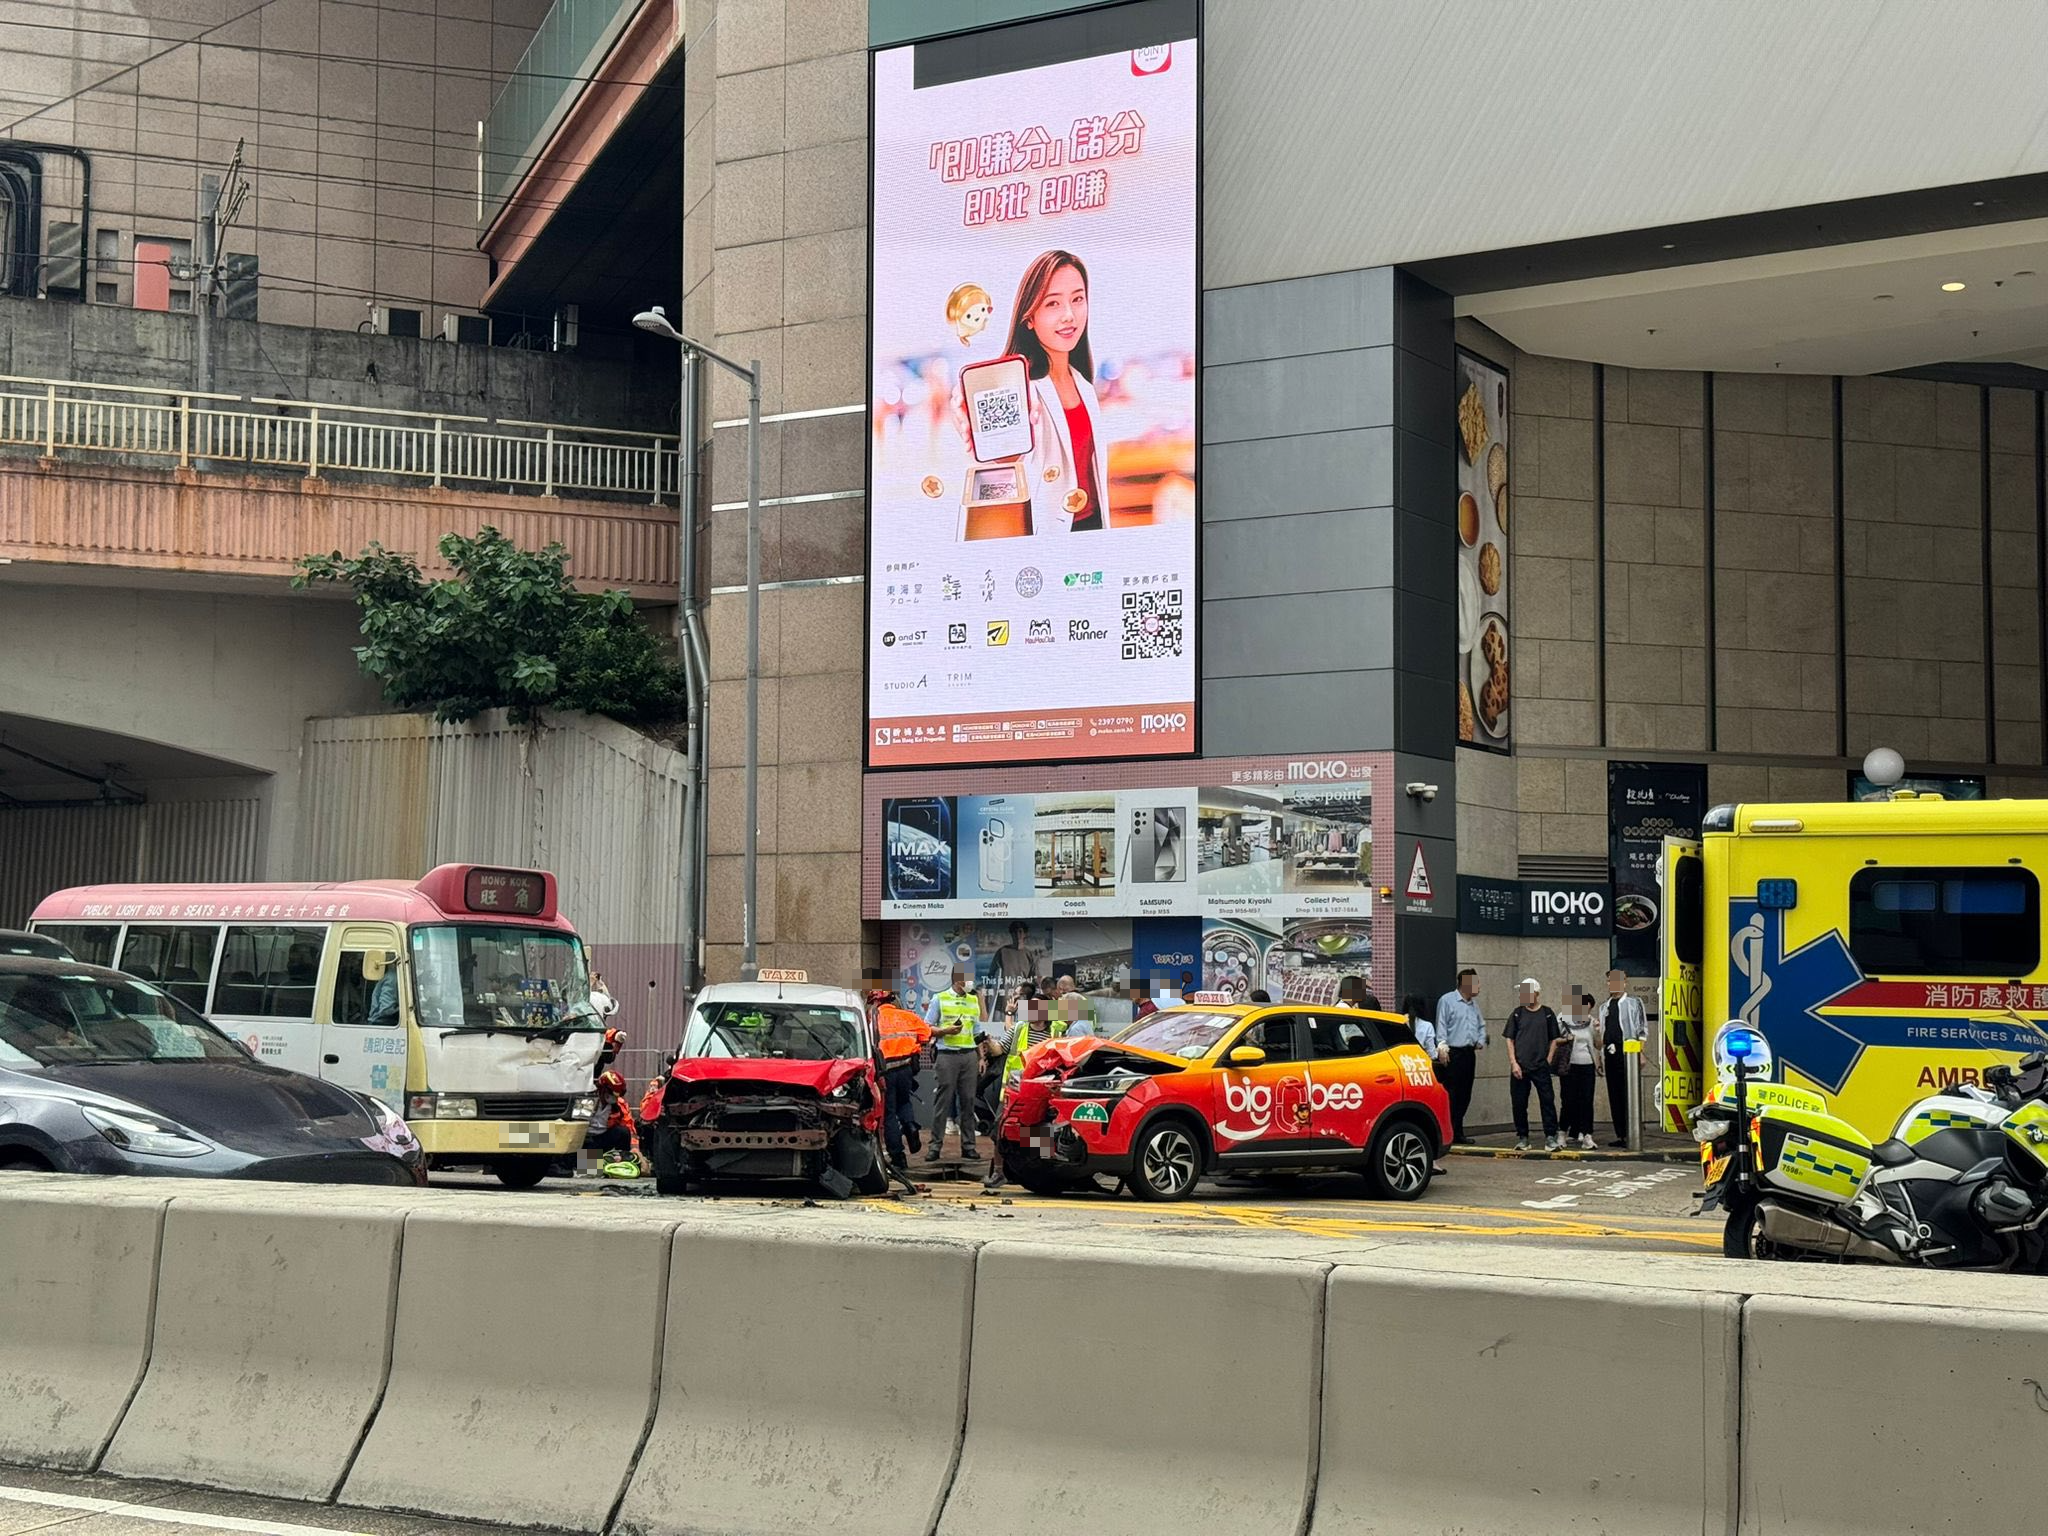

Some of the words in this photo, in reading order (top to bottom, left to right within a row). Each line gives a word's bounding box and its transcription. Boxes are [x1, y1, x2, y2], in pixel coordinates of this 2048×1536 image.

[1039, 169, 1107, 215] 即賺
[1069, 619, 1090, 631] Pro
[1069, 630, 1108, 641] Runner
[884, 681, 915, 689] STUDIO
[1098, 718, 1115, 726] 2397
[1116, 717, 1134, 725] 0790
[1141, 713, 1186, 729] MOKO
[1231, 769, 1284, 782] 更多精彩由
[1287, 760, 1347, 780] MOKO
[1350, 766, 1371, 778] 出發
[891, 840, 947, 856] IMAX
[481, 875, 506, 886] MONG
[480, 887, 529, 909] 旺角
[1304, 896, 1330, 904] Collect
[1331, 896, 1350, 904] Point
[1531, 890, 1604, 915] MOKO
[80, 904, 112, 917] PUBLIC
[115, 904, 144, 917] LIGHT
[145, 904, 165, 917] BUS
[184, 904, 216, 917] SEATS
[761, 970, 804, 981] TAXI
[981, 975, 997, 985] This
[1196, 992, 1225, 1004] TAXI
[1907, 1027, 1938, 1038] FIRE
[1941, 1028, 2007, 1042] SERVICES
[363, 1037, 406, 1055] 請即登記
[1399, 1055, 1430, 1072] 的士
[1405, 1071, 1434, 1087] TAXI
[1222, 1072, 1271, 1125] big
[1304, 1070, 1364, 1110] bee
[1769, 1091, 1809, 1110] POLICE
[1086, 1108, 1094, 1116] 4
